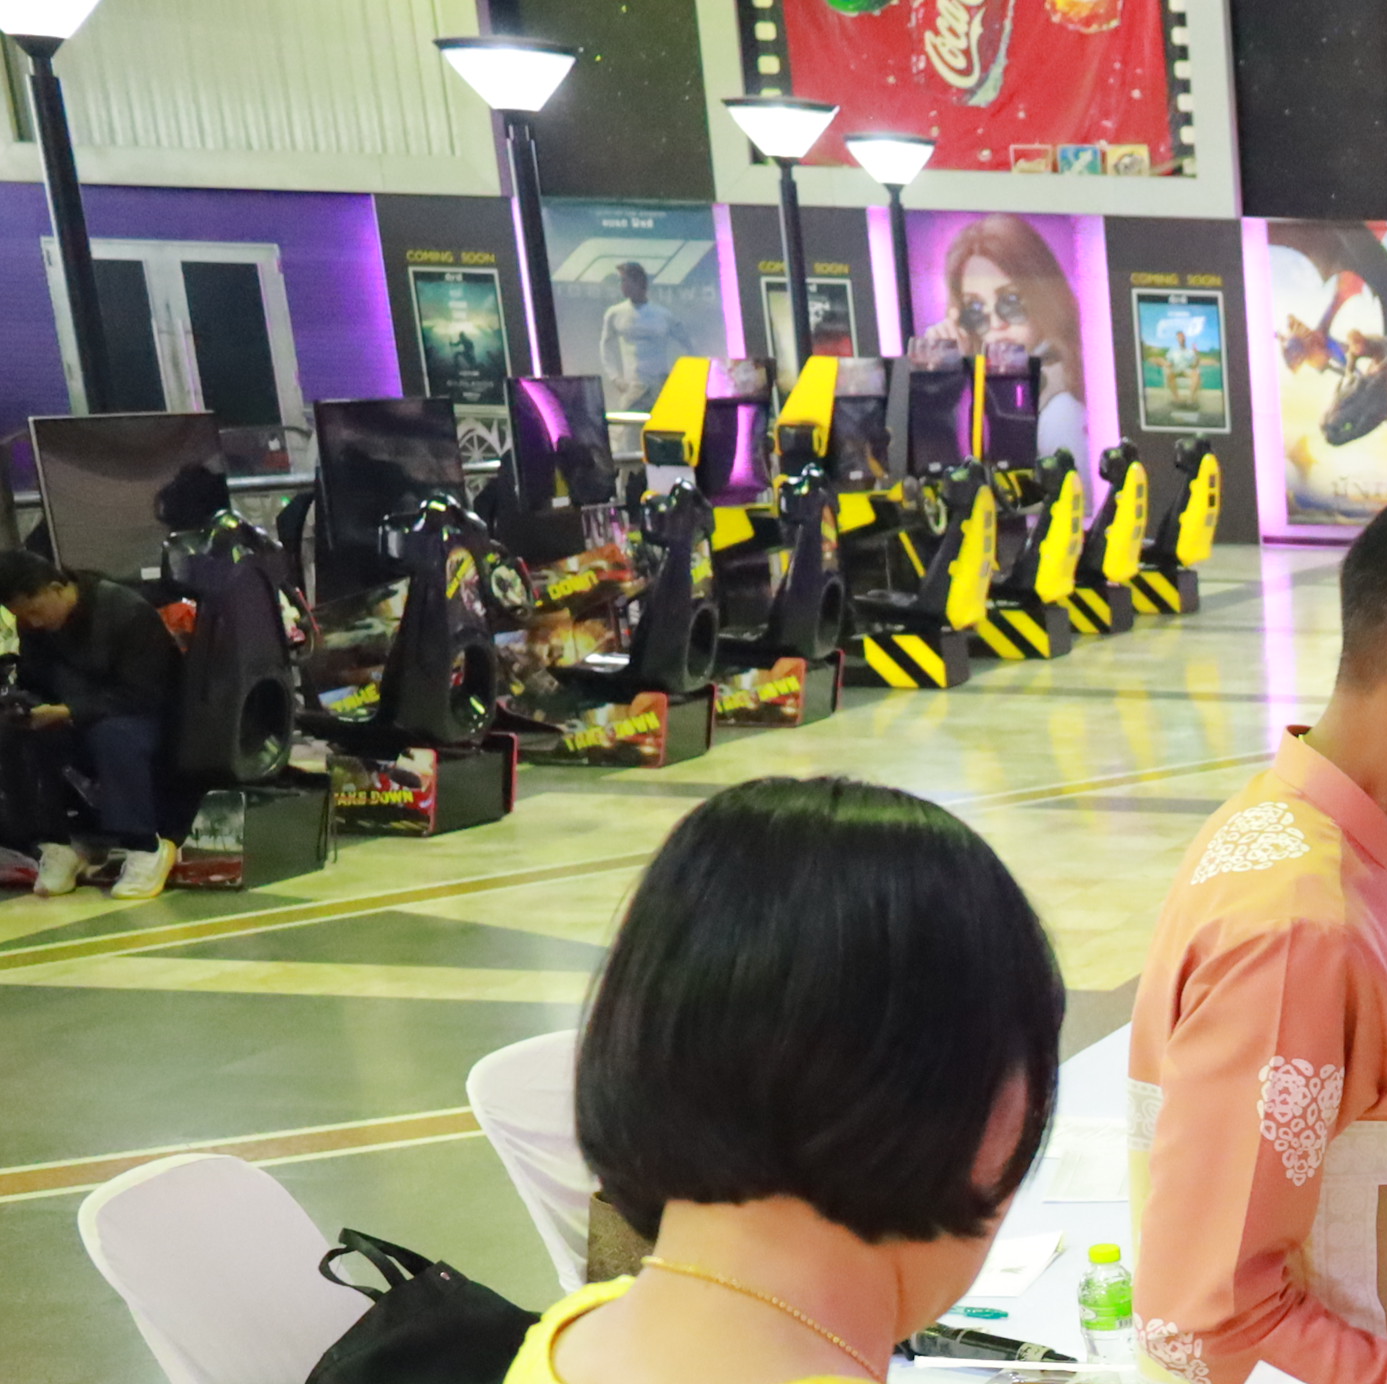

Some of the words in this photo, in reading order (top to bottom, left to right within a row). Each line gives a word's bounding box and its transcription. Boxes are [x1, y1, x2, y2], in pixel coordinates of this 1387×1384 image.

[406, 250, 454, 264] COMING
[460, 251, 496, 265] SOON
[813, 262, 850, 275] SOON
[1130, 272, 1180, 286] COMING
[1187, 274, 1224, 287] SOON
[370, 790, 414, 806] DOWN
